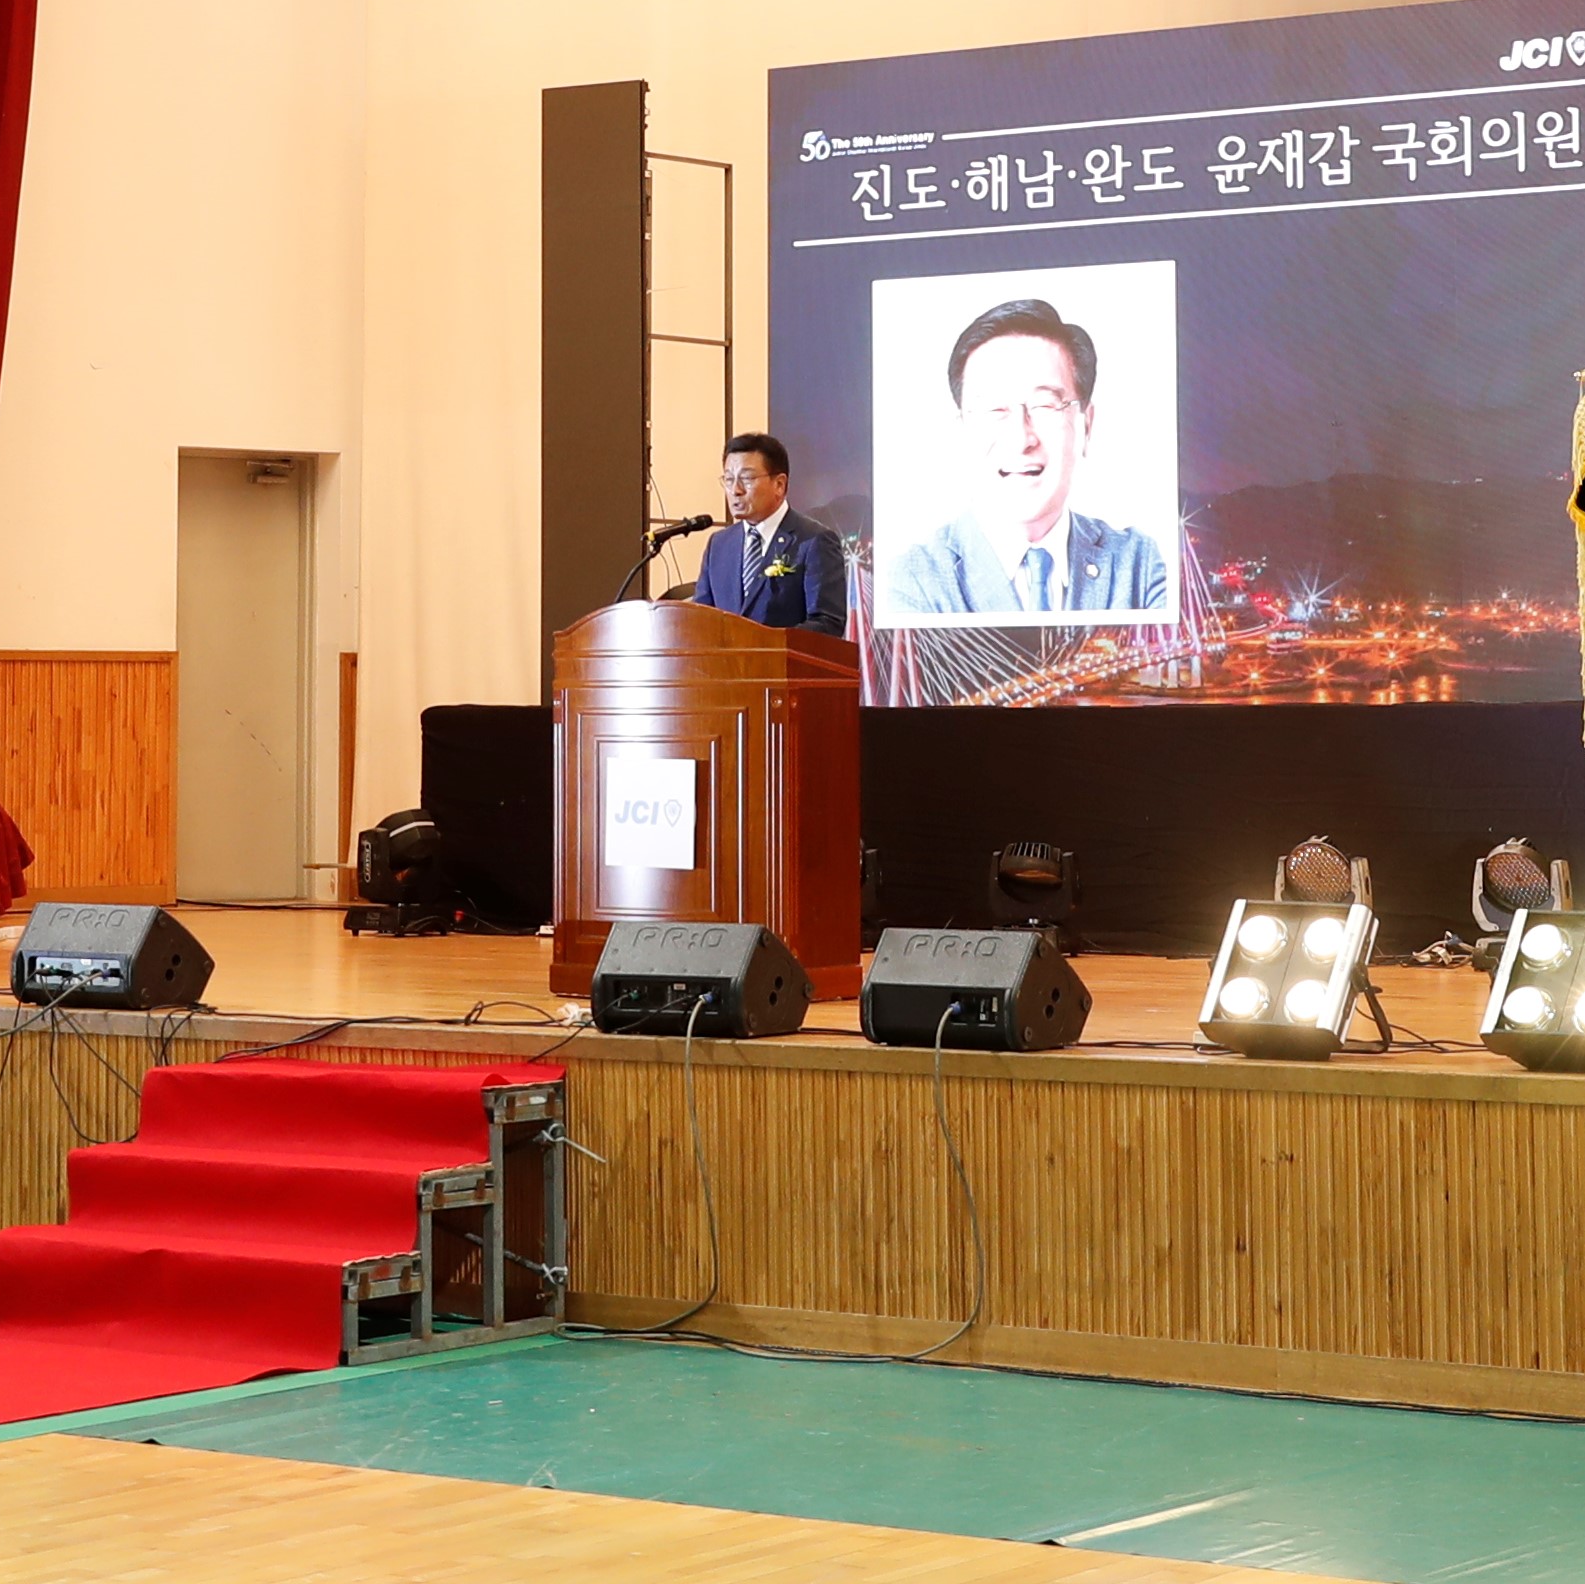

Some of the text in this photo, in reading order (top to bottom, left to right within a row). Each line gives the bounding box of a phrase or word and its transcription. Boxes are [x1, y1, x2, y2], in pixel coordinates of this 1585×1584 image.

[1499, 36, 1564, 71] JCI
[1206, 124, 1361, 194] 윤재갑
[1371, 106, 1584, 181] 국회의원
[614, 799, 660, 827] JCI
